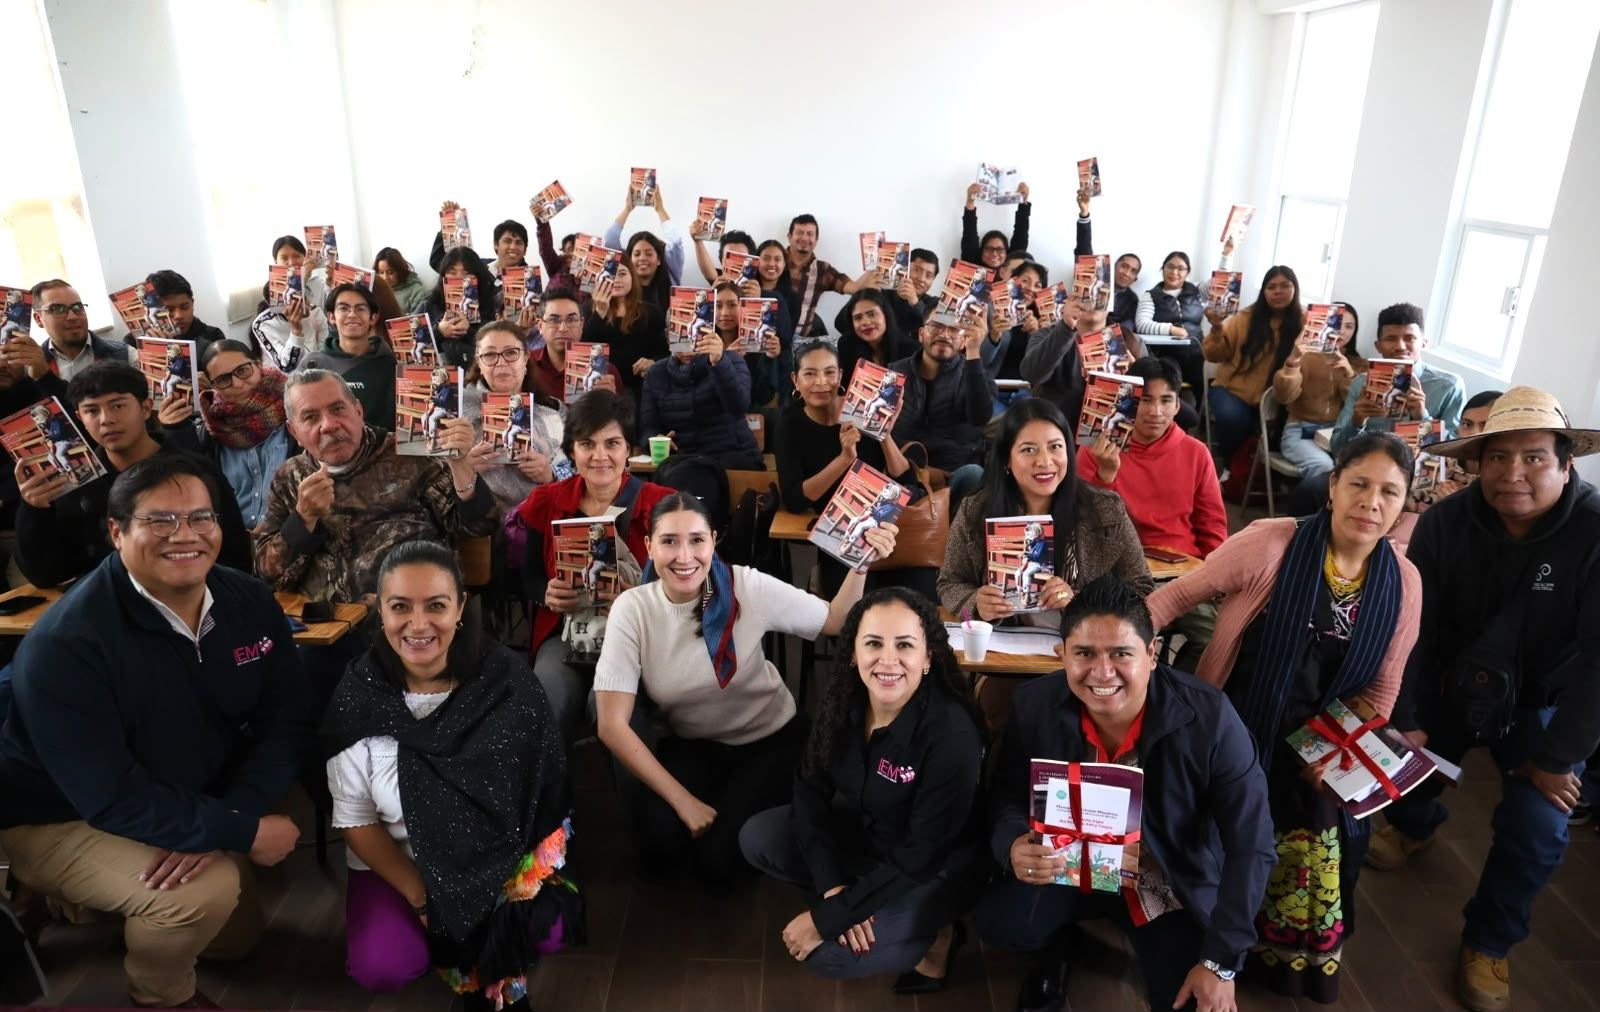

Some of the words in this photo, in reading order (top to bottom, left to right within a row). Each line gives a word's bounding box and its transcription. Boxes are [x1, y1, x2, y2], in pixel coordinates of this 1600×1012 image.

[575, 622, 589, 634] H
[233, 643, 259, 662] IEM
[878, 757, 899, 780] IEM
